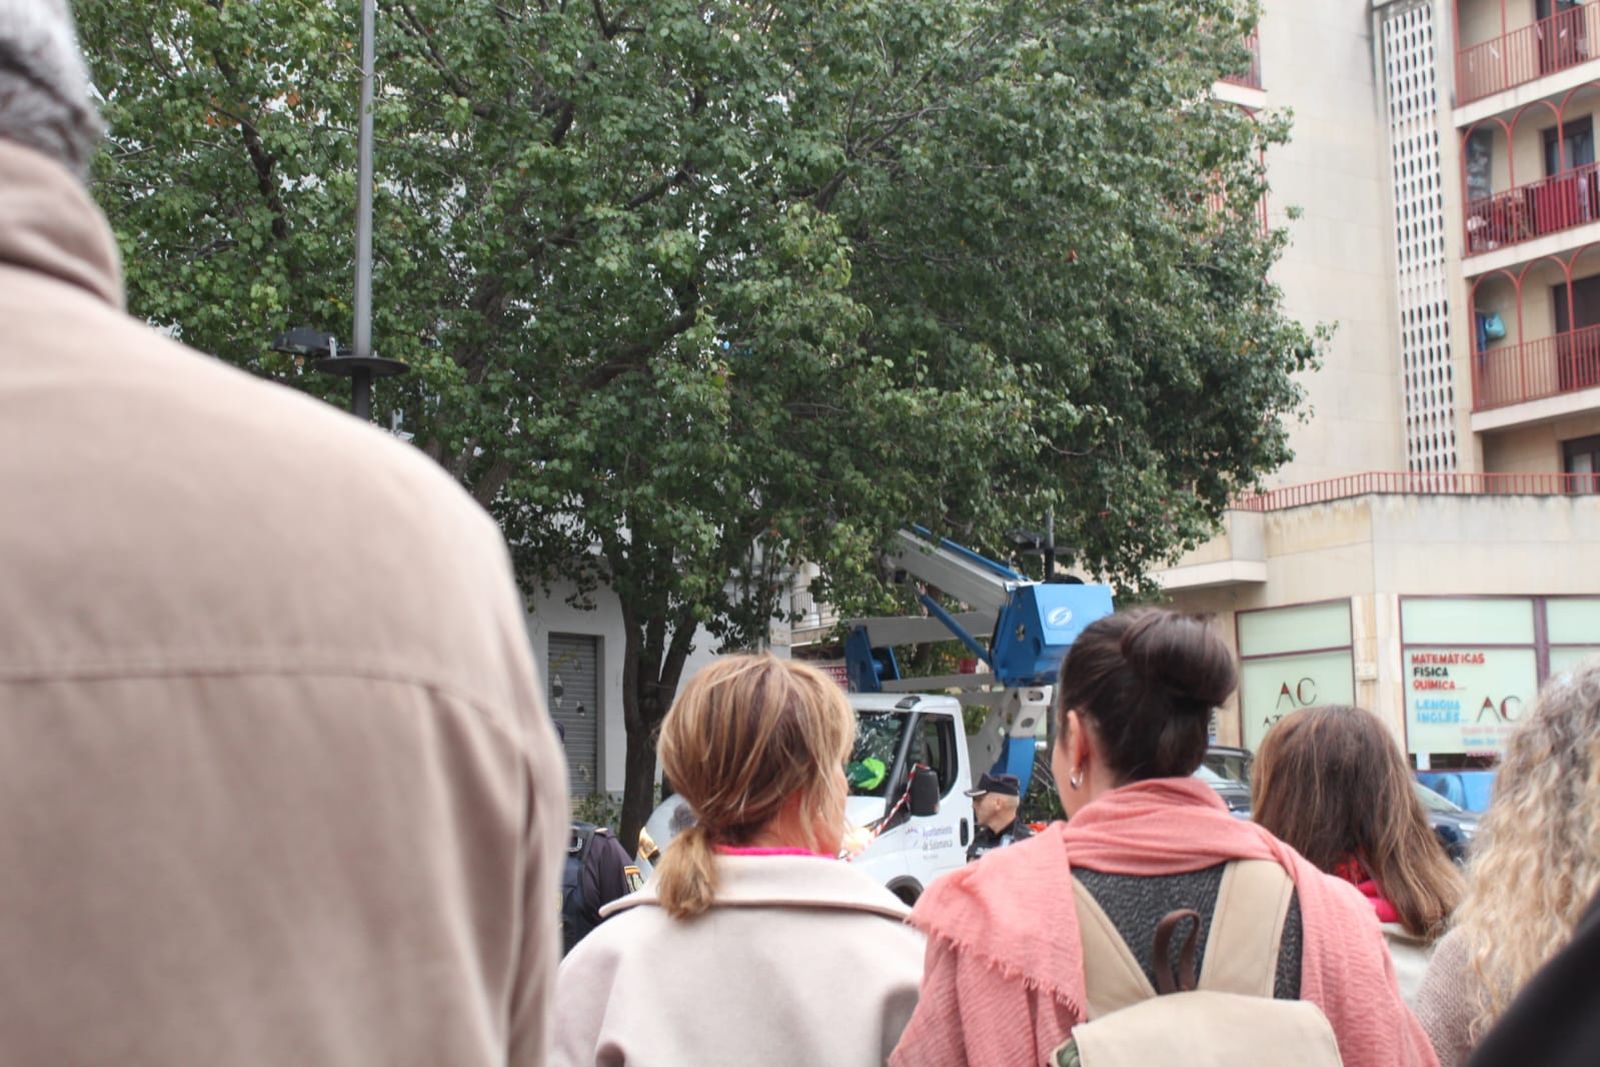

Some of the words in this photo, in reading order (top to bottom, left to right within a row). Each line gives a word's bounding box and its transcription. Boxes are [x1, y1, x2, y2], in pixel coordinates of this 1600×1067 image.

[1413, 667, 1449, 677] FISICA
[1276, 676, 1317, 710] AC
[1476, 695, 1522, 723] AC
